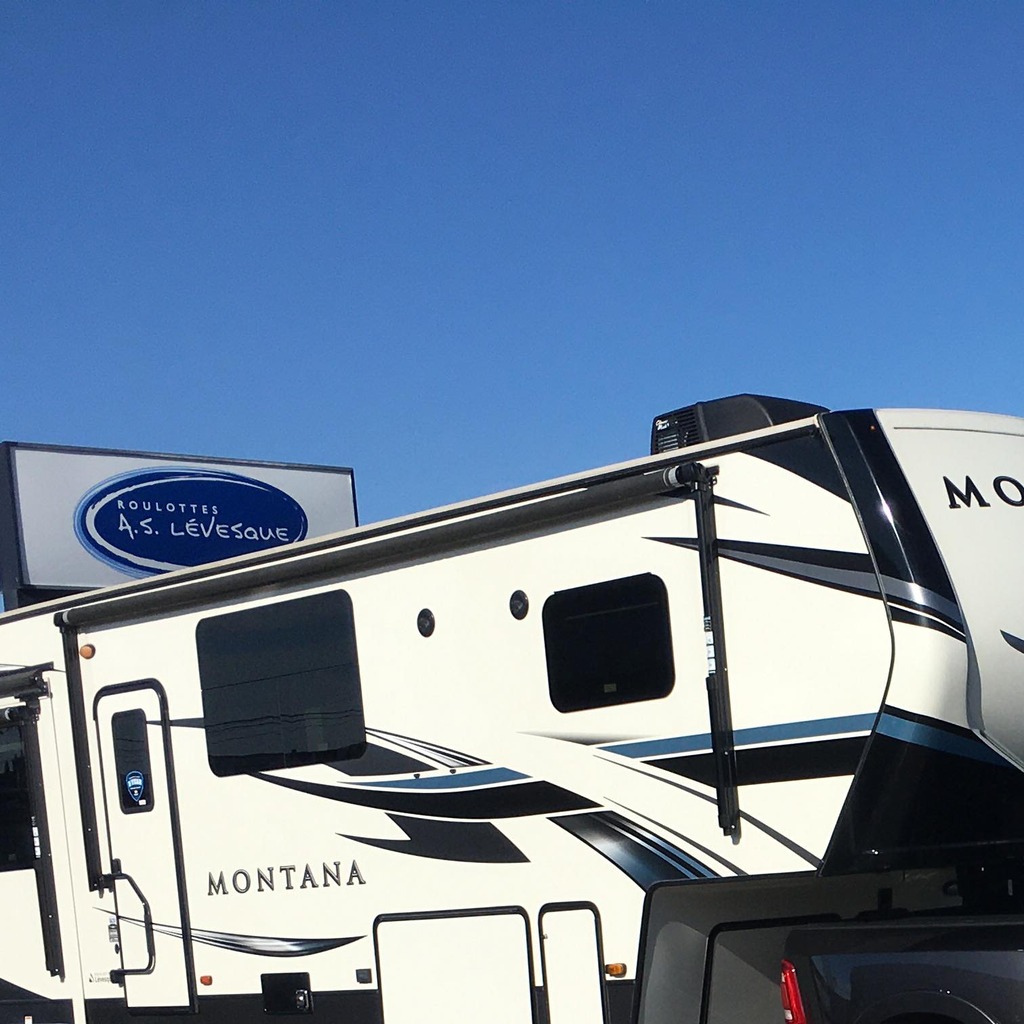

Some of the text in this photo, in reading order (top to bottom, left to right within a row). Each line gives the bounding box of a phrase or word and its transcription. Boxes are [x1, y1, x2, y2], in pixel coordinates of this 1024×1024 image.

[117, 500, 218, 514] ROULOTTES
[118, 513, 289, 541] A.S. LÉVESQUE
[207, 859, 366, 896] MONTANA
